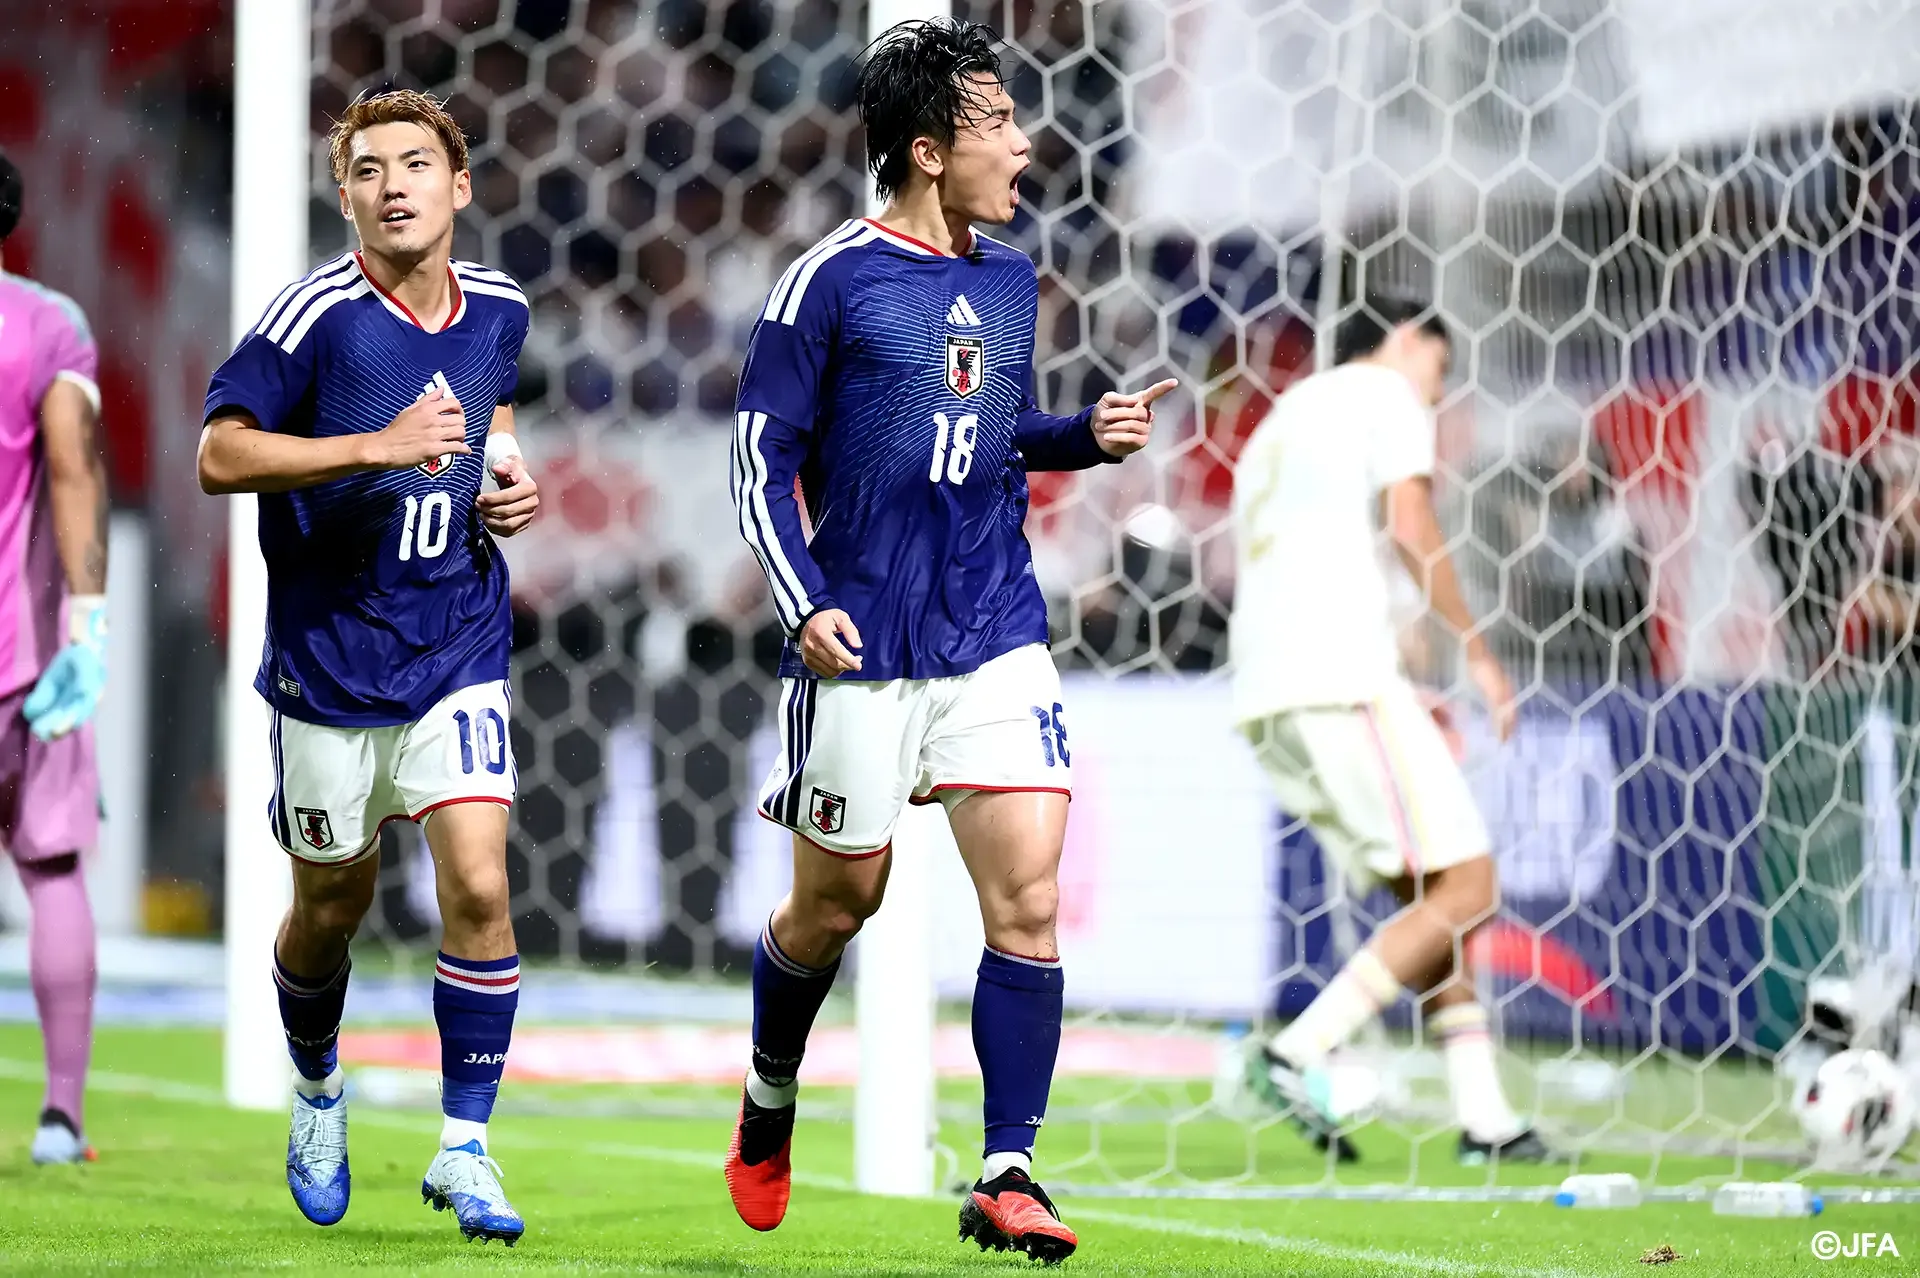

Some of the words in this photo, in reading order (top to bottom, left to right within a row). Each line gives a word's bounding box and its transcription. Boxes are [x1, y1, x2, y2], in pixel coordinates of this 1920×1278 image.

[953, 338, 974, 346] JAPAN
[954, 378, 972, 389] JFA
[929, 412, 979, 485] 18
[399, 491, 452, 561] 10
[453, 708, 506, 775] 10
